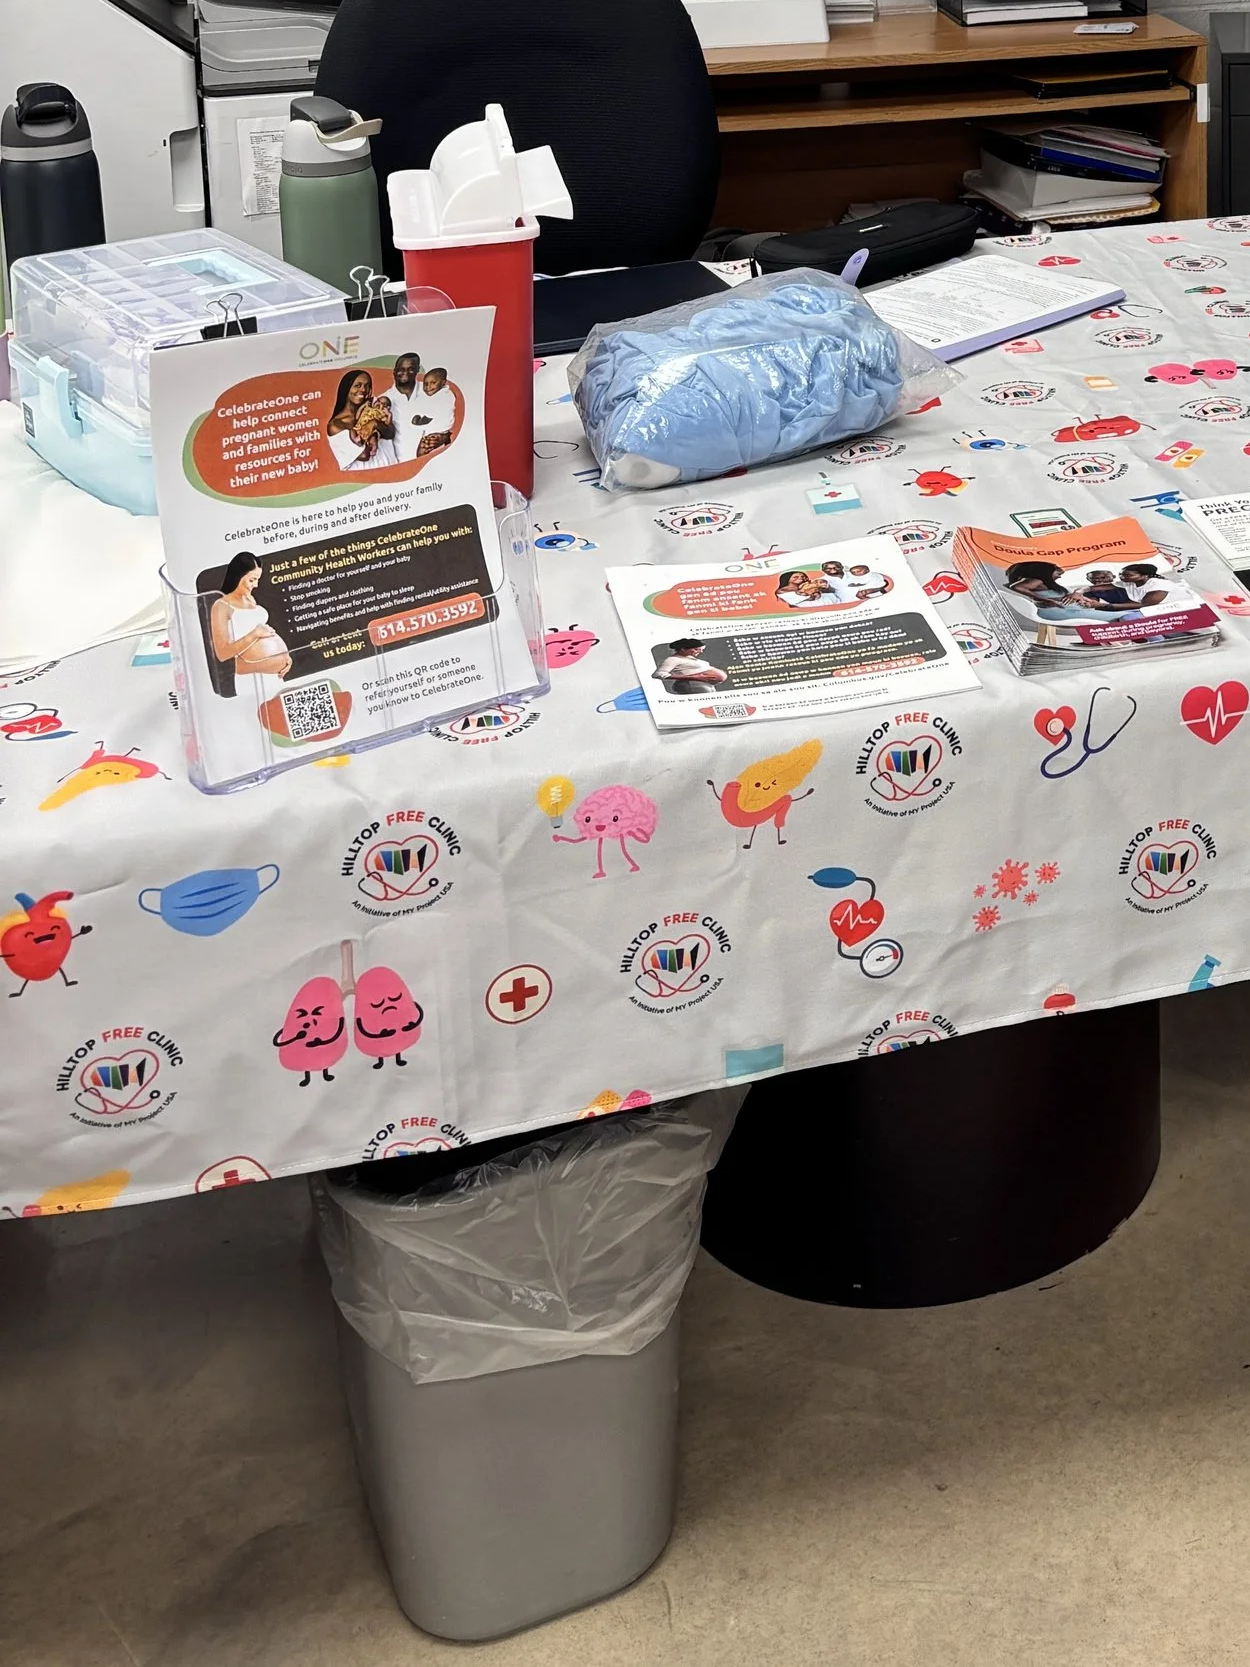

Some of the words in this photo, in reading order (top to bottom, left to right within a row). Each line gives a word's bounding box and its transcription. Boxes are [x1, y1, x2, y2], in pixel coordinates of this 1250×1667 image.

[300, 336, 360, 360] ONE
[218, 395, 299, 418] CelebrateOne
[302, 390, 321, 401] can
[233, 417, 259, 429] help
[262, 406, 307, 423] connect
[222, 426, 276, 448] pregnant
[279, 418, 319, 434] women
[223, 446, 244, 460] and
[247, 436, 292, 455] families
[295, 430, 321, 444] with
[230, 471, 259, 488] their
[262, 468, 285, 481] new
[288, 459, 319, 474] baby!
[235, 452, 291, 472] resources
[294, 447, 311, 459] for
[225, 520, 290, 542] CelebrateOne
[292, 516, 300, 525] is
[302, 512, 323, 523] here
[325, 509, 335, 518] to
[336, 504, 356, 516] help
[358, 500, 374, 511] you
[376, 494, 392, 505] and
[394, 490, 413, 502] your
[416, 482, 443, 495] family
[263, 530, 297, 545] before,
[299, 523, 329, 537] during
[331, 517, 347, 528] and
[349, 511, 371, 524] after
[373, 503, 411, 518] delivery.
[269, 562, 290, 573] Just
[299, 555, 316, 566] few
[318, 549, 329, 560] of
[330, 545, 345, 557] the
[347, 539, 376, 553] things
[377, 524, 438, 545] CelebrateOne
[271, 565, 324, 584] Community
[325, 556, 356, 570] Health
[357, 546, 395, 562] Workers
[397, 543, 412, 552] can
[413, 537, 432, 548] help
[434, 533, 450, 544] you
[451, 525, 473, 538] with:
[994, 545, 1034, 556] Doula
[1066, 540, 1126, 553] Program
[677, 582, 754, 594] CelebrateOne
[377, 601, 478, 639] 614.570.3592
[323, 650, 334, 659] us
[336, 640, 366, 655] today:
[362, 682, 373, 691] Or
[375, 676, 395, 687] scan
[395, 671, 413, 681] this
[414, 666, 428, 676] QR
[429, 658, 450, 671] code
[451, 656, 461, 664] to
[364, 690, 386, 703] refer
[388, 678, 428, 696] yourself
[426, 676, 436, 684] or
[437, 664, 476, 680] someone
[367, 702, 385, 715] you
[385, 697, 409, 708] know
[410, 692, 420, 701] to
[422, 675, 484, 697] CelebrateOne.
[505, 712, 541, 738] HILLTOP
[856, 721, 890, 774] HILLTOP
[895, 712, 930, 726] FREE
[932, 717, 962, 756] CLINIC
[943, 781, 955, 795] USA
[341, 822, 380, 876] HILLTOP
[386, 810, 425, 826] FREE
[428, 816, 461, 856] CLINIC
[1118, 827, 1153, 875] HILLTOP
[1159, 819, 1190, 831] FREE
[1192, 824, 1217, 859] CLINIC
[620, 922, 658, 973] HILLTOP
[663, 913, 699, 926] FREE
[701, 916, 731, 953] CLINIC
[896, 1010, 930, 1023] FREE
[56, 1039, 96, 1091] HILLTOP
[102, 1027, 144, 1042] FREE
[147, 1030, 183, 1067] CLINIC
[401, 1117, 437, 1129] FREE
